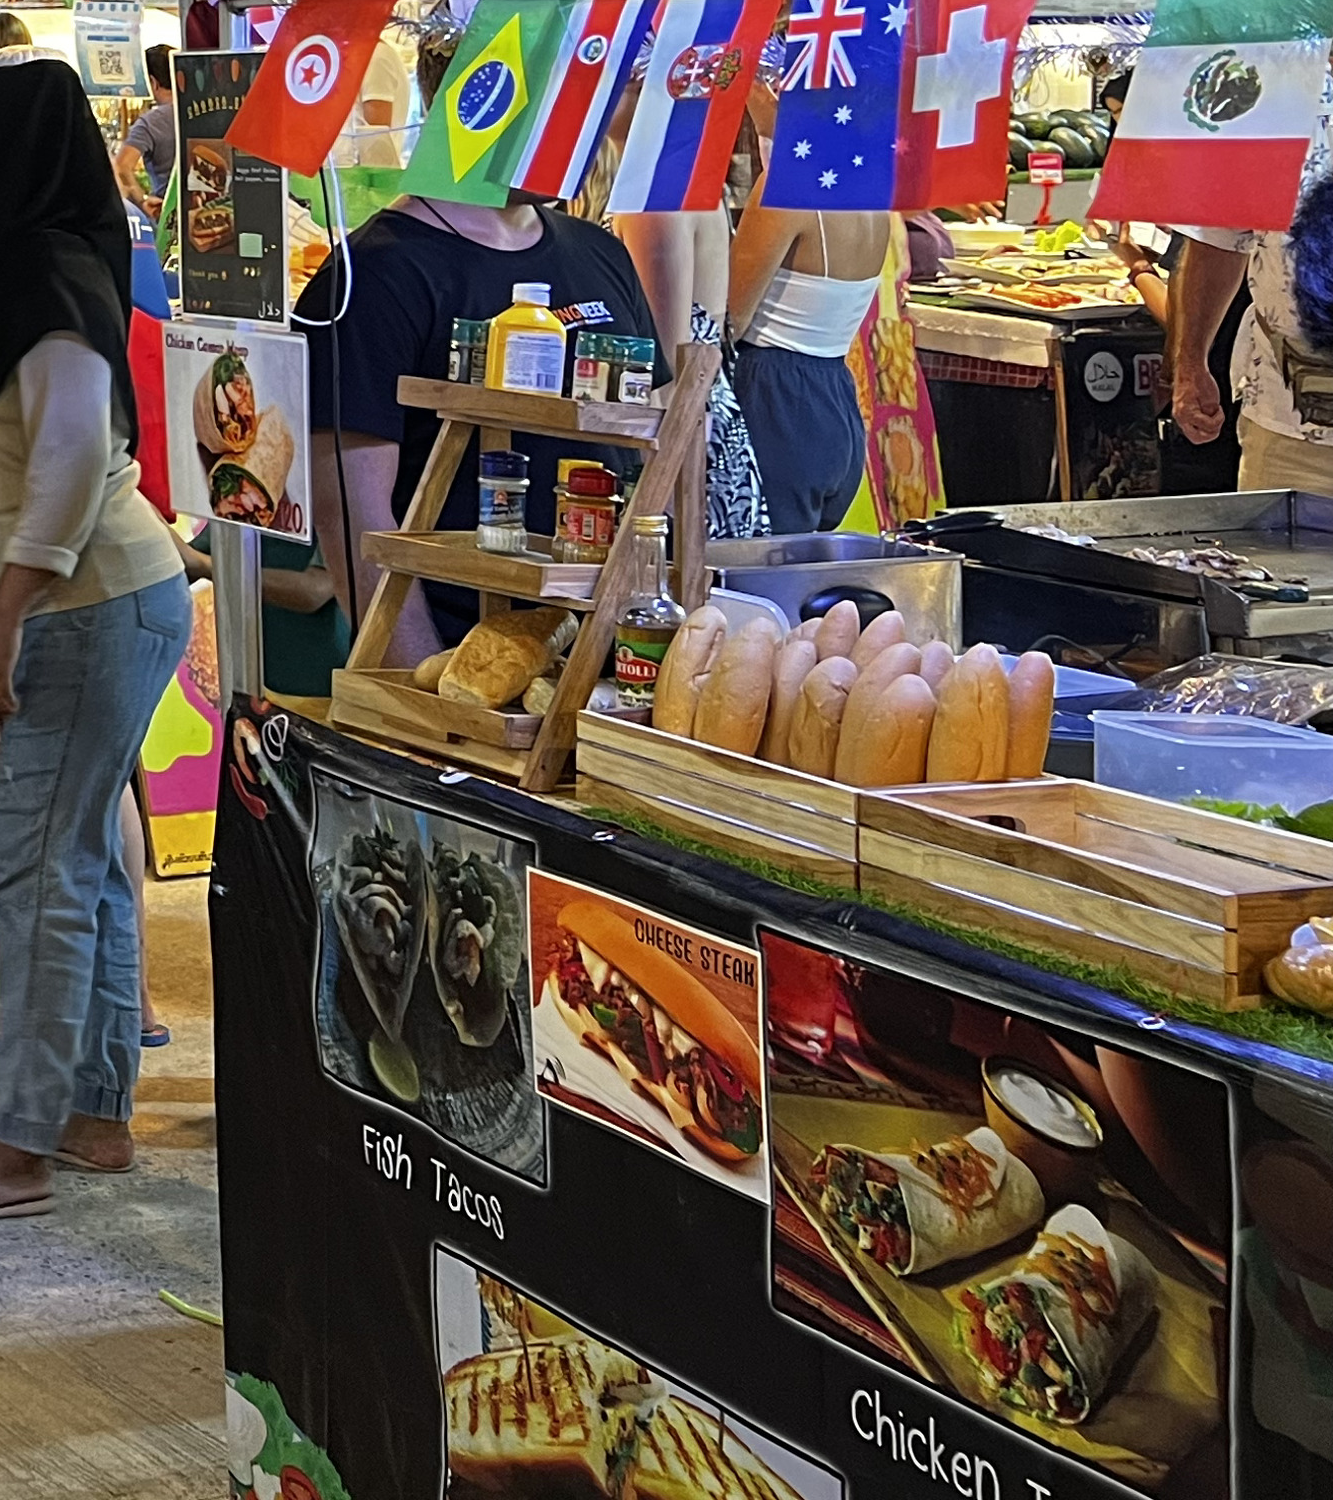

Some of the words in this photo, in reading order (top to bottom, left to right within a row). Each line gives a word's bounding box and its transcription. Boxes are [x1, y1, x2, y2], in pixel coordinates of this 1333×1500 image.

[634, 918, 693, 964] CHEESE
[700, 945, 755, 988] STEAK
[363, 1124, 412, 1190] Fish
[430, 1157, 505, 1240] Tacos
[851, 1389, 1000, 1500] Chicken
